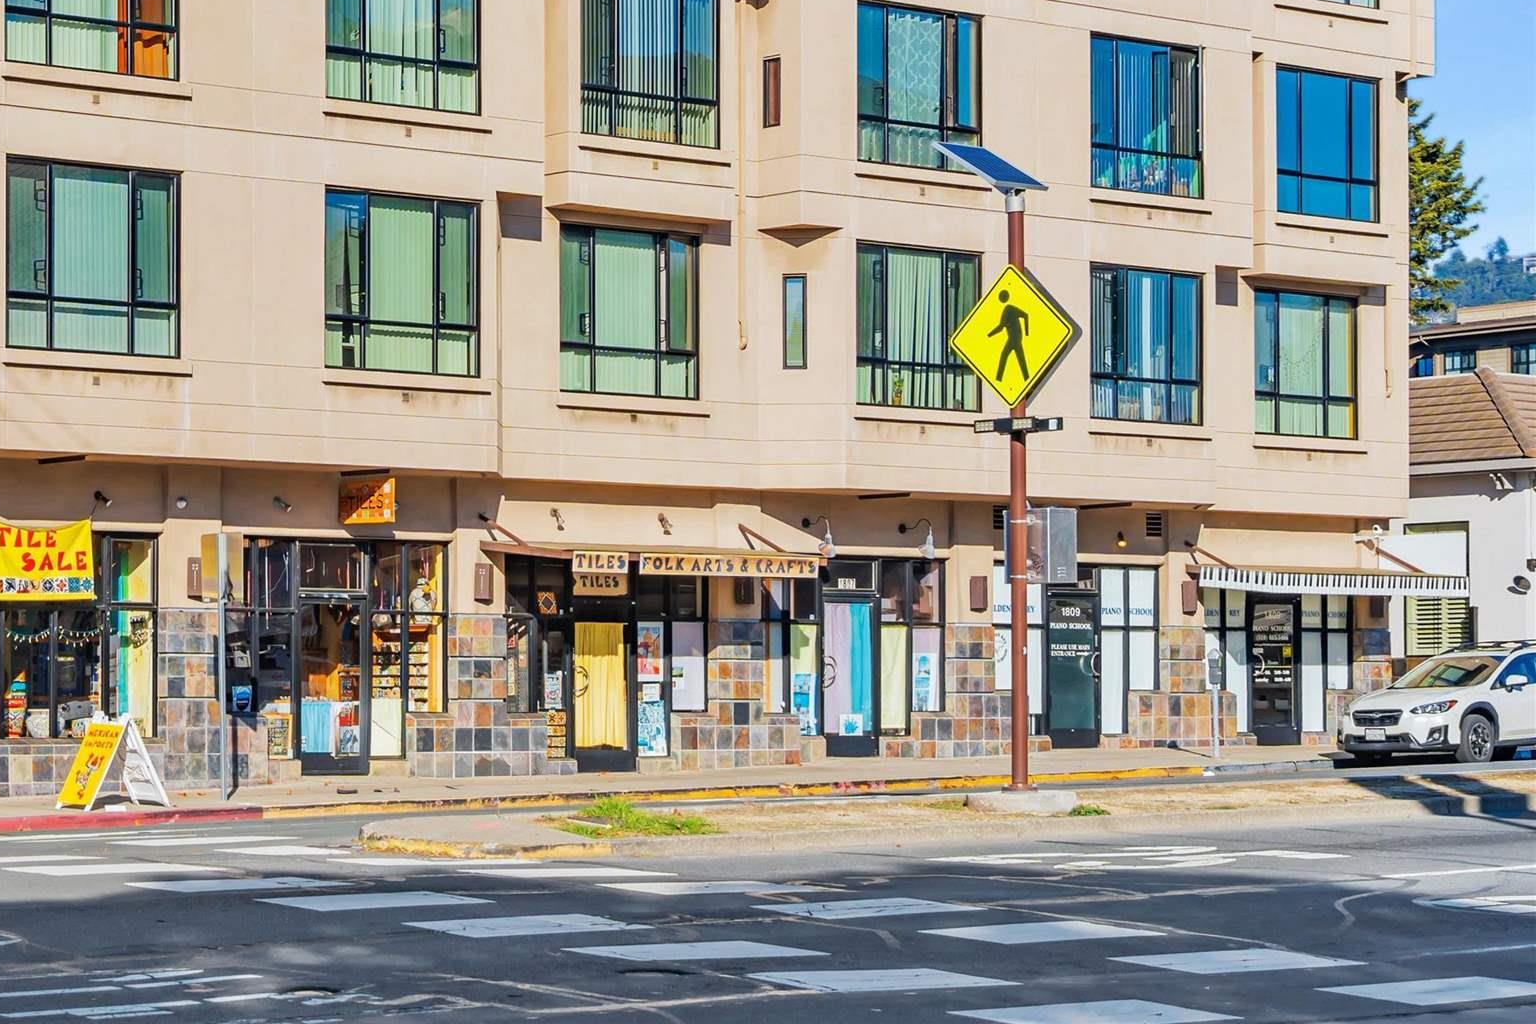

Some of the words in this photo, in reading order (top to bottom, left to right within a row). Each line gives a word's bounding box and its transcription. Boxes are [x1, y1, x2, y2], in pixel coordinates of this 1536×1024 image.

[348, 494, 384, 509] TILES
[21, 551, 87, 572] SALE
[575, 554, 626, 569] TILES
[643, 556, 684, 571] FOLK
[691, 558, 734, 572] ARTS
[740, 559, 749, 572] &
[756, 559, 817, 574] CRAFTS
[579, 575, 620, 588] TILES
[1060, 607, 1081, 617] 1809
[1101, 607, 1122, 615] PIANO
[1050, 622, 1068, 630] PIANO
